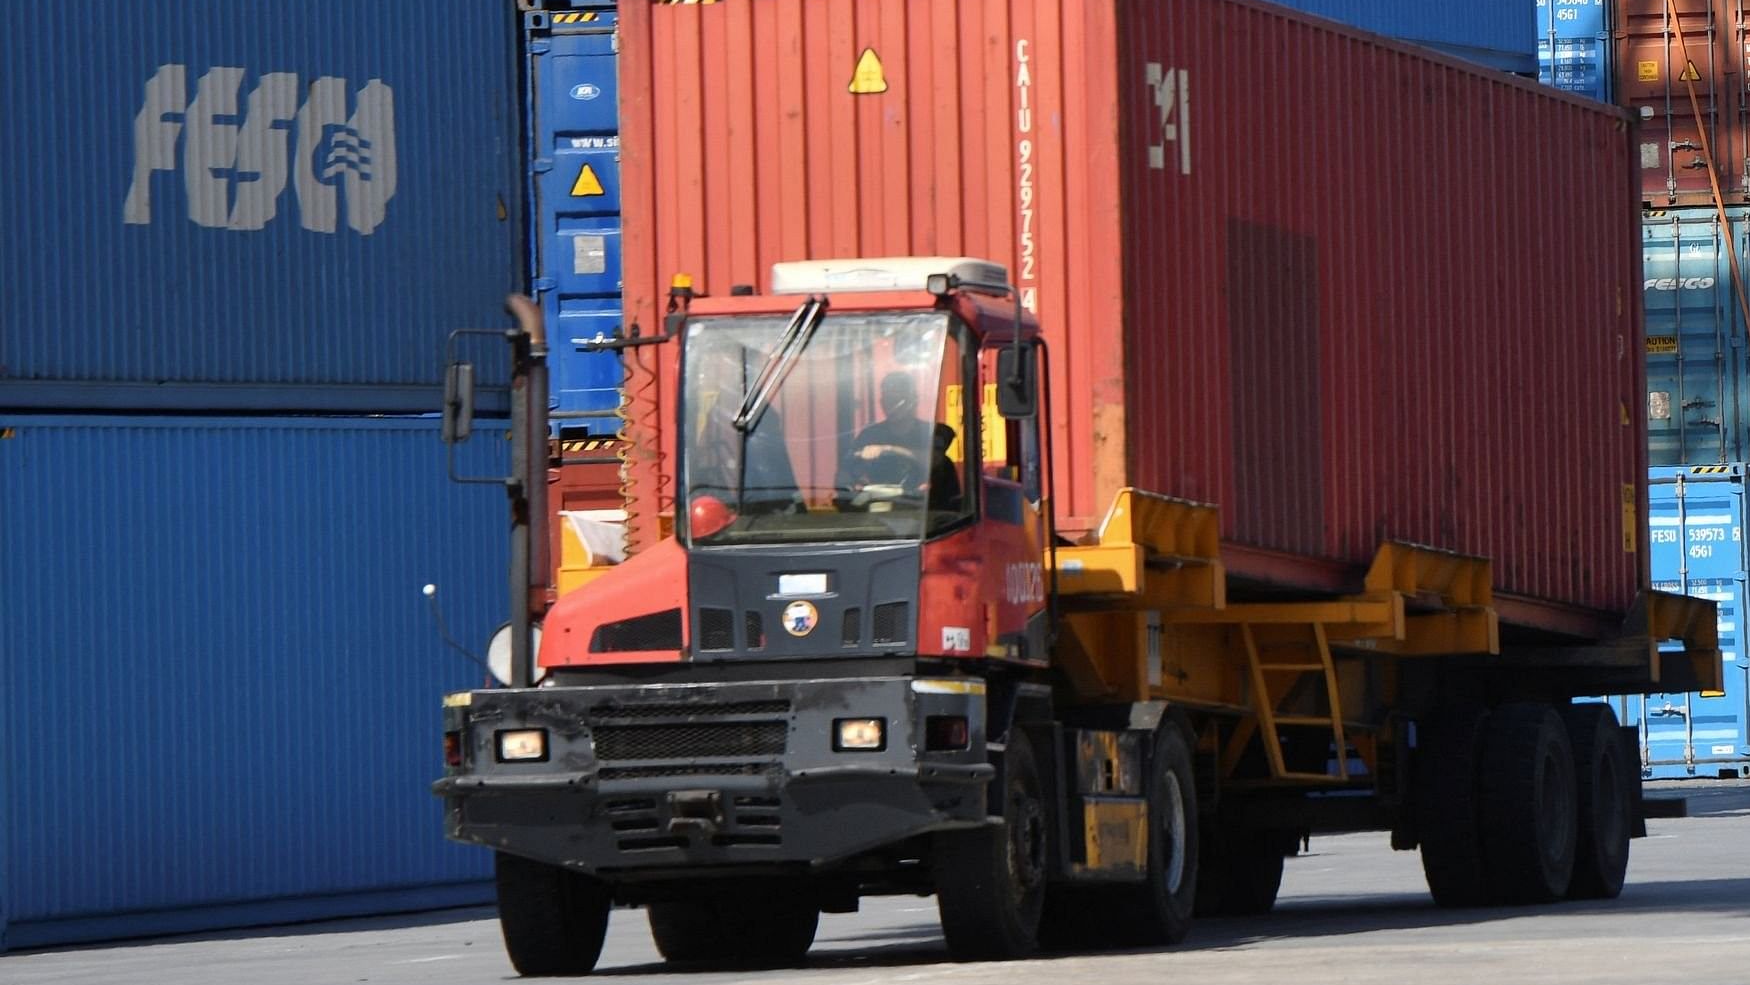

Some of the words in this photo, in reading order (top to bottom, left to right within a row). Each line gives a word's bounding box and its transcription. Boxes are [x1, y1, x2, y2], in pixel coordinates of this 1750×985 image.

[1557, 9, 1577, 20] 45G1
[1016, 39, 1031, 132] CAIU
[1019, 140, 1034, 280] 929752
[1644, 278, 1714, 290] FESCO
[1646, 337, 1675, 345] AUTION
[1652, 530, 1676, 542] FESU
[1689, 528, 1724, 541] 539573
[1689, 546, 1712, 558] 45G1
